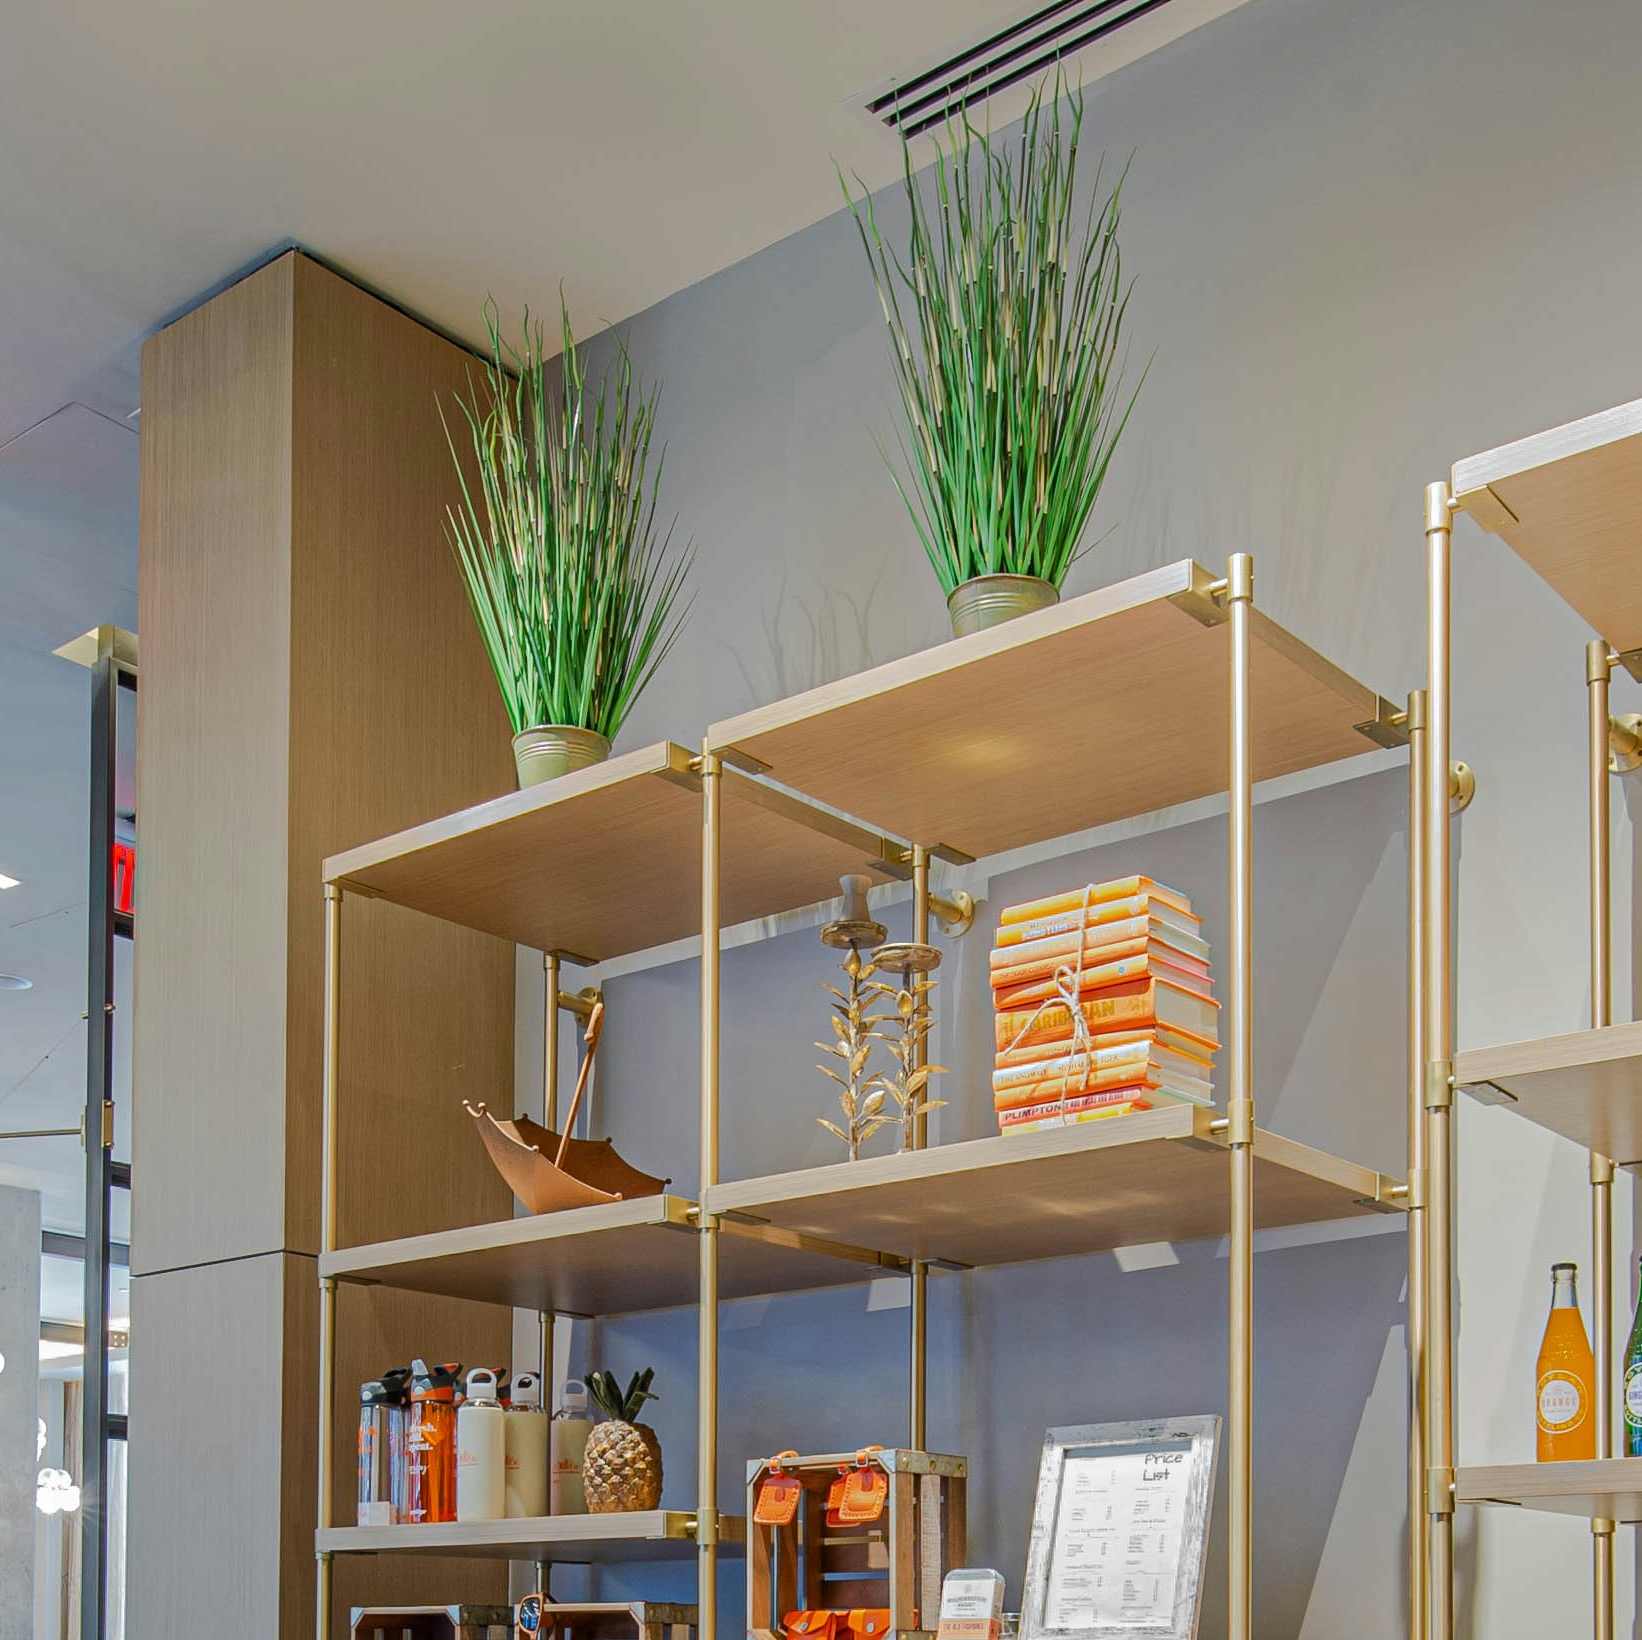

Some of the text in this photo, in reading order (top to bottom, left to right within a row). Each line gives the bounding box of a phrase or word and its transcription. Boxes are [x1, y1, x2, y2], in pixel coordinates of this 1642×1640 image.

[1004, 1105, 1062, 1121] PLIMPTON
[1144, 1453, 1184, 1465] Price
[1143, 1467, 1170, 1482] List
